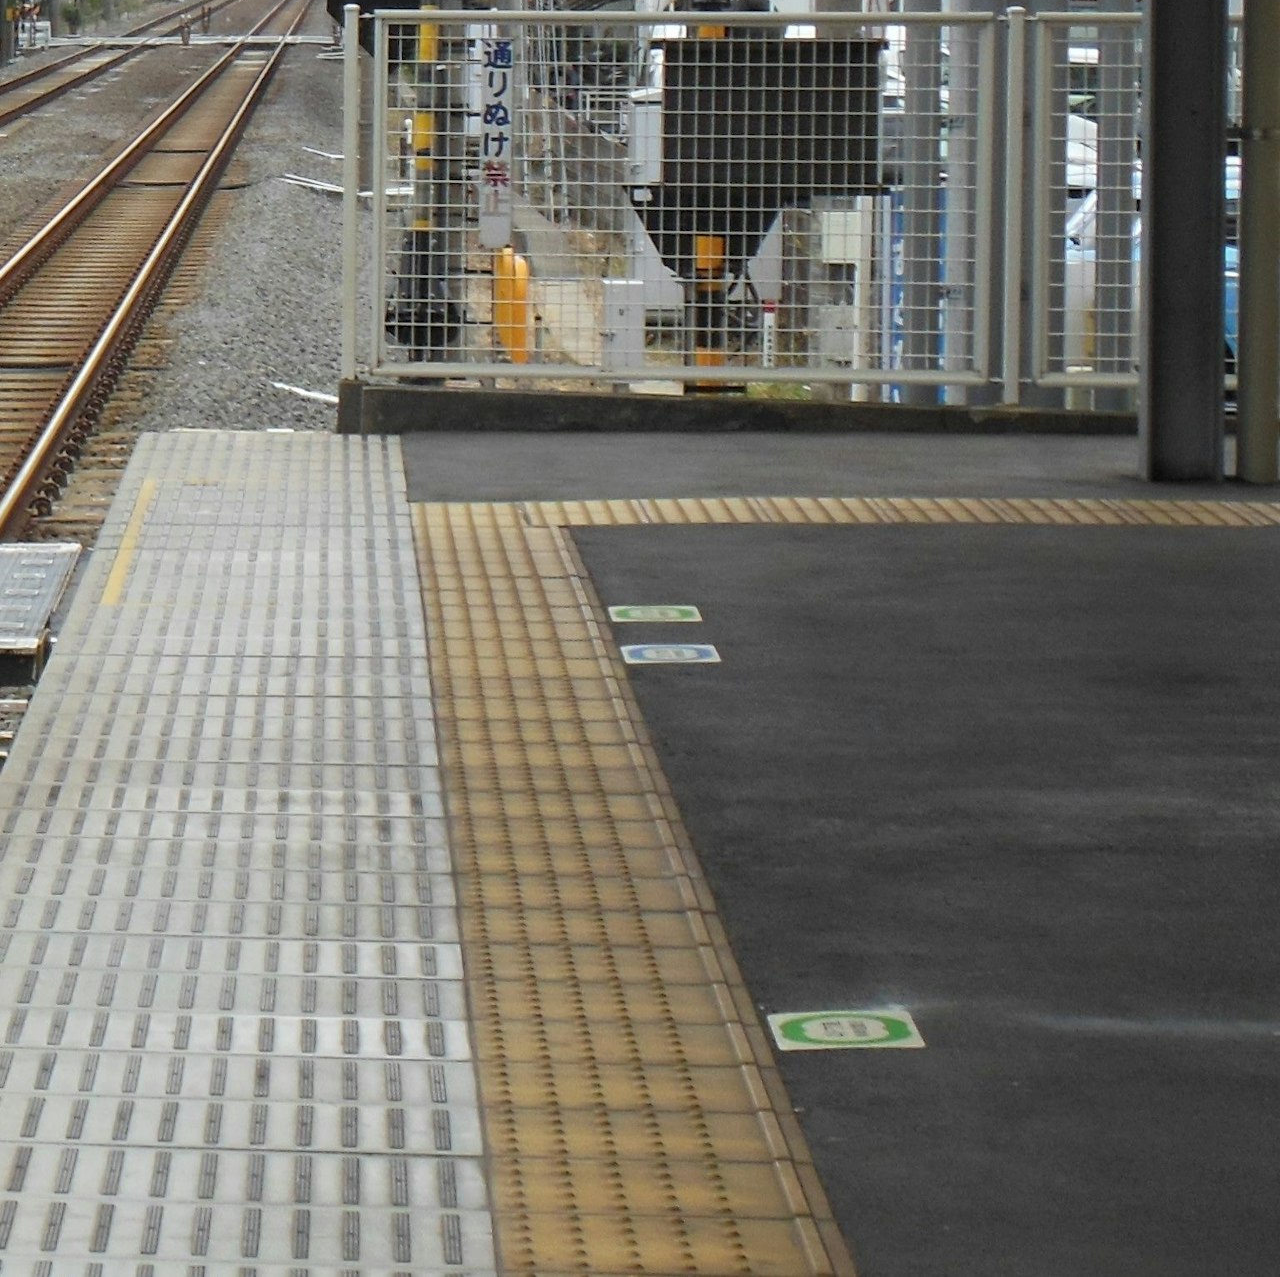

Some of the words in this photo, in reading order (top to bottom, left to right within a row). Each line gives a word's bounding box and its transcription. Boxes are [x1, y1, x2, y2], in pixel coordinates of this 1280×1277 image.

[483, 40, 512, 213] 通りぬけ禁止
